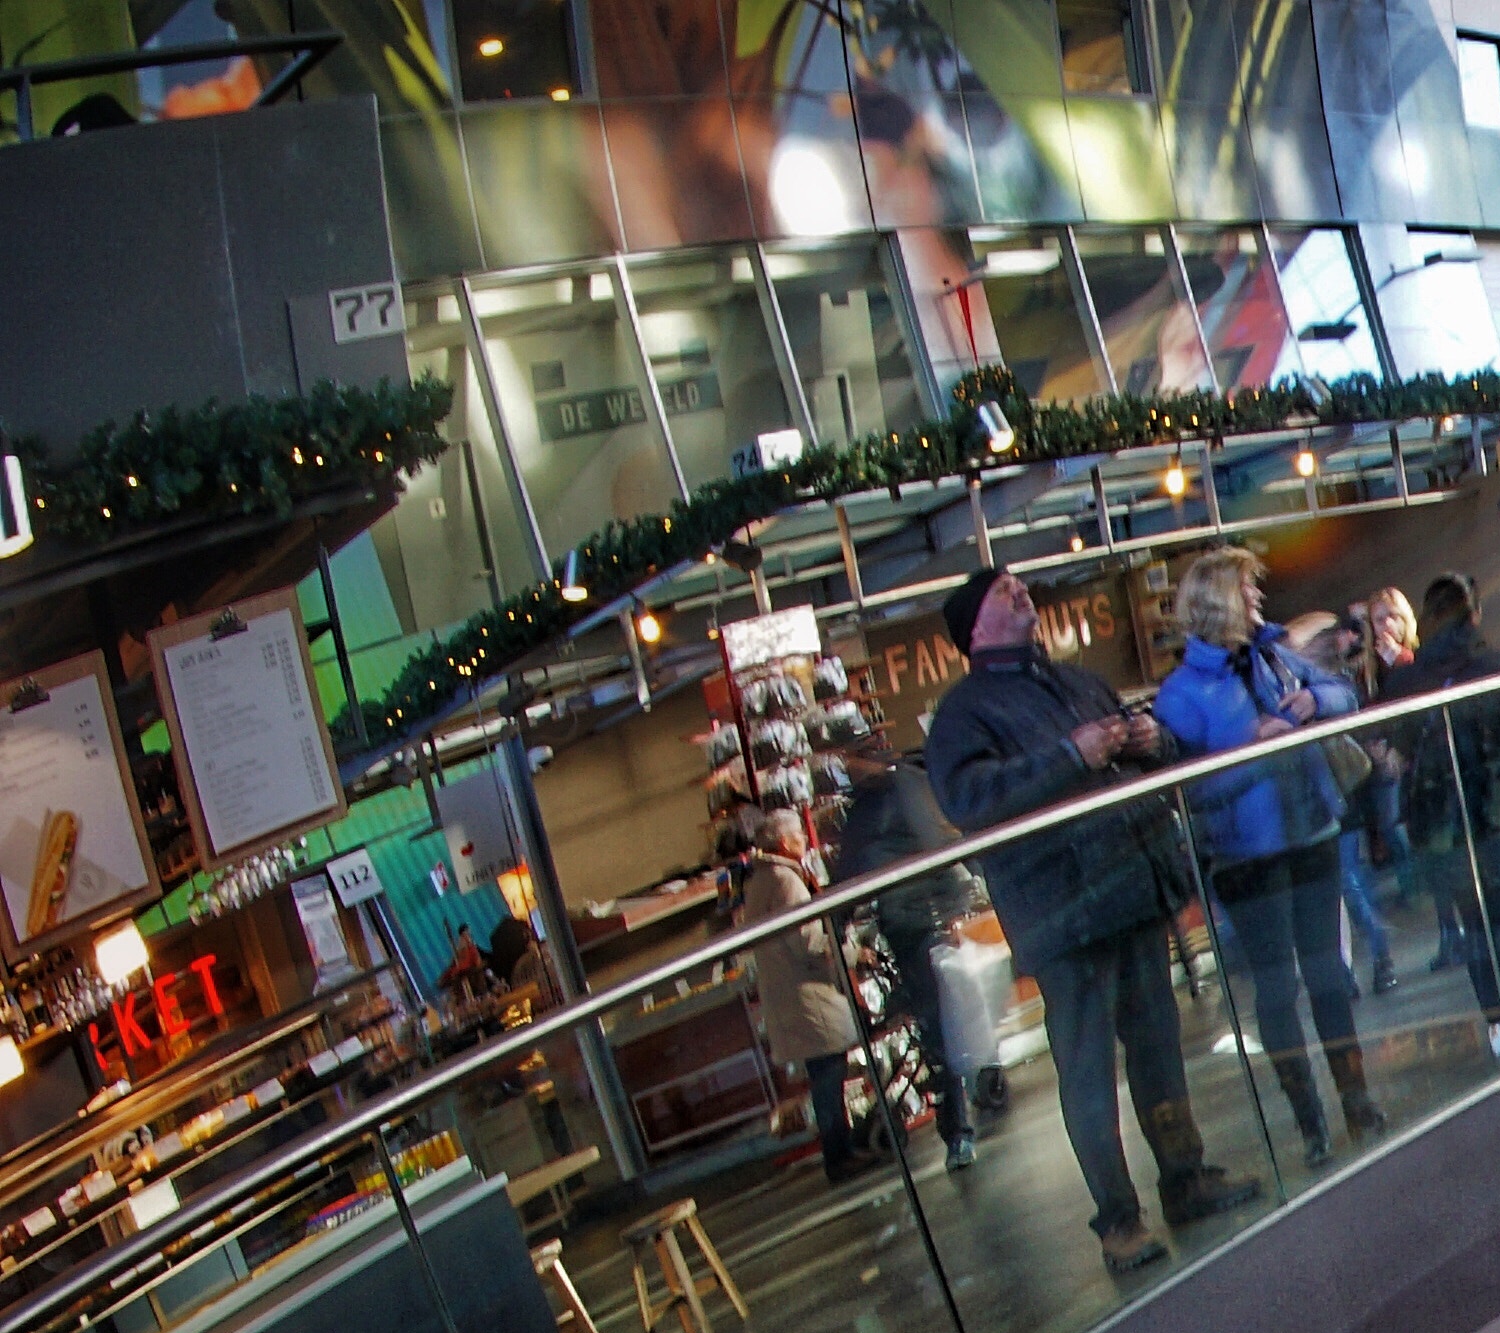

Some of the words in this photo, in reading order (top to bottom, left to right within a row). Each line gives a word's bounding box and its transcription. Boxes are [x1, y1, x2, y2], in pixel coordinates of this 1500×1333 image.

[335, 286, 395, 333] 77
[561, 401, 590, 432] DE
[339, 864, 373, 891] 112
